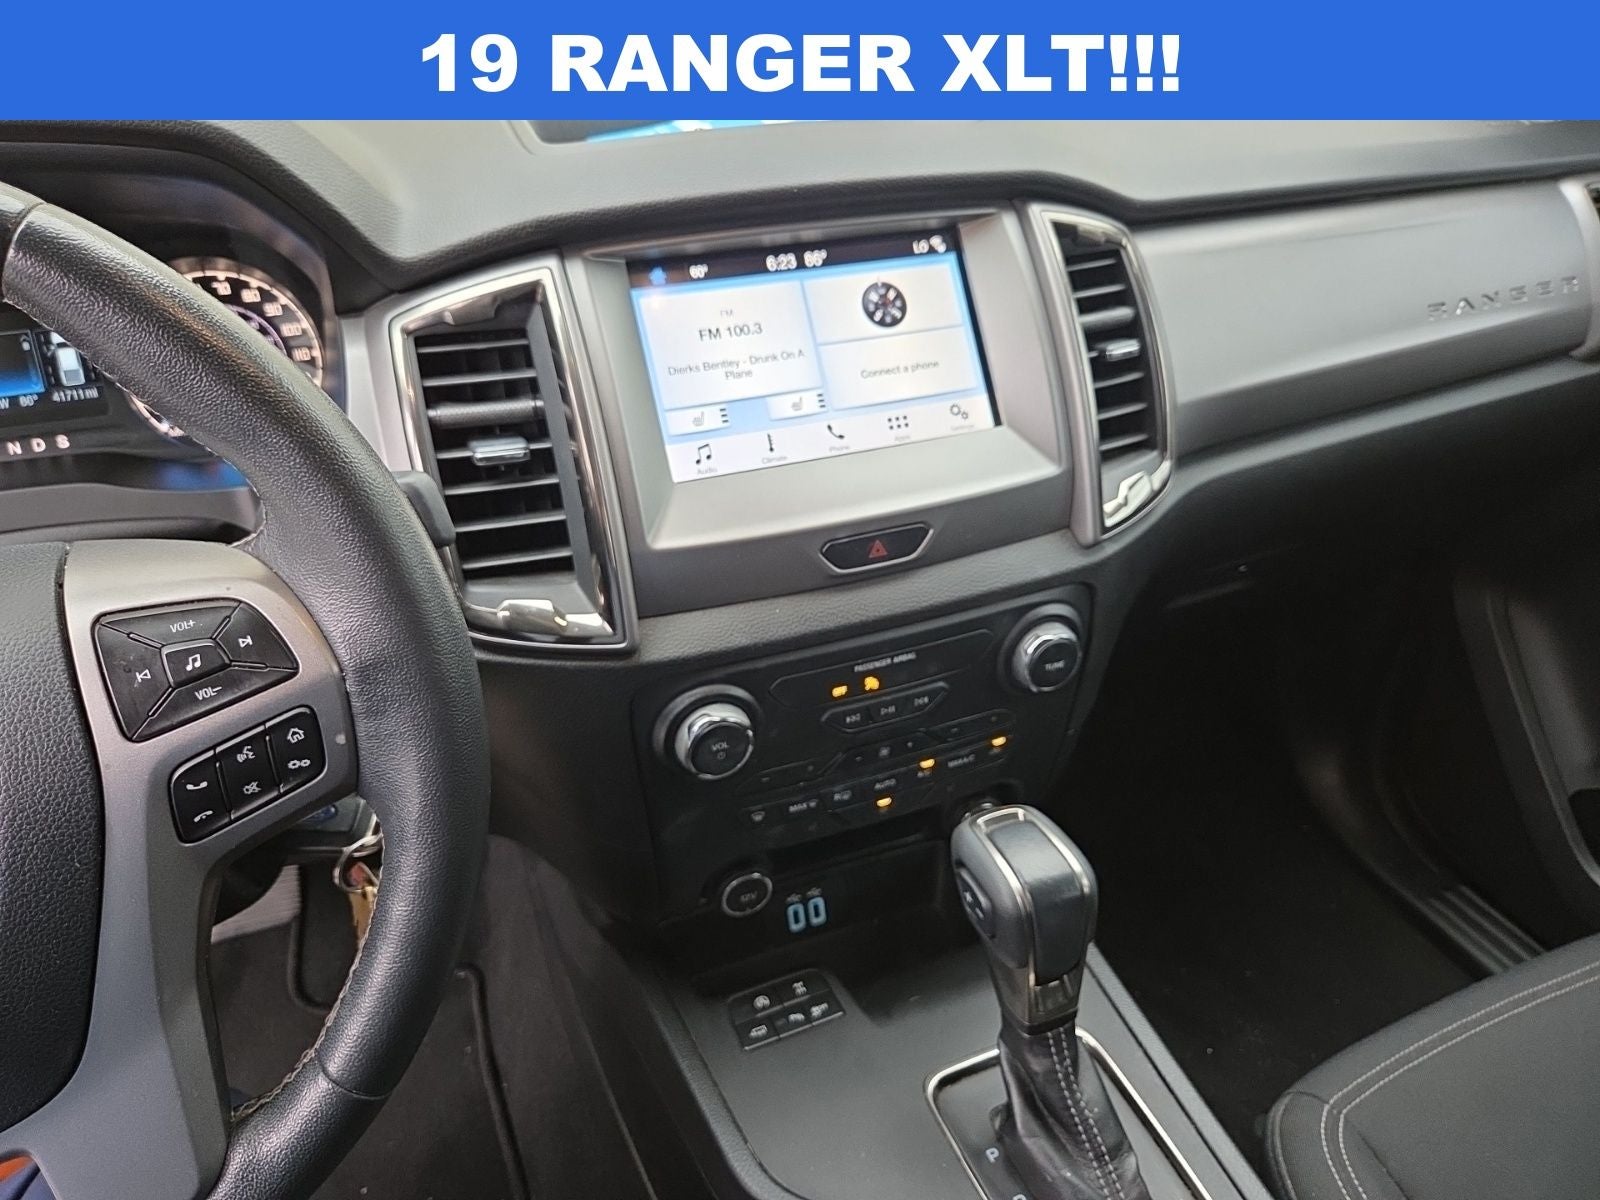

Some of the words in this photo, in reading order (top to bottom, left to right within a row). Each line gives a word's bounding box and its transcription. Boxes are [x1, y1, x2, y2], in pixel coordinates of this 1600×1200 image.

[766, 253, 797, 272] 6:23
[698, 326, 722, 342] FM
[726, 322, 764, 338] 100.3
[668, 363, 701, 377] Dierks
[702, 357, 741, 372] Bentley
[749, 351, 780, 366] Drunk
[780, 350, 796, 361] On
[798, 348, 806, 358] A
[860, 366, 901, 379] Connect
[911, 360, 940, 374] phone
[724, 369, 753, 381] Plane
[6, 441, 22, 456] N
[30, 437, 46, 452] D
[55, 434, 70, 449] S
[169, 619, 196, 633] VOL+
[711, 741, 730, 752] VOL
[985, 1147, 999, 1163] P
